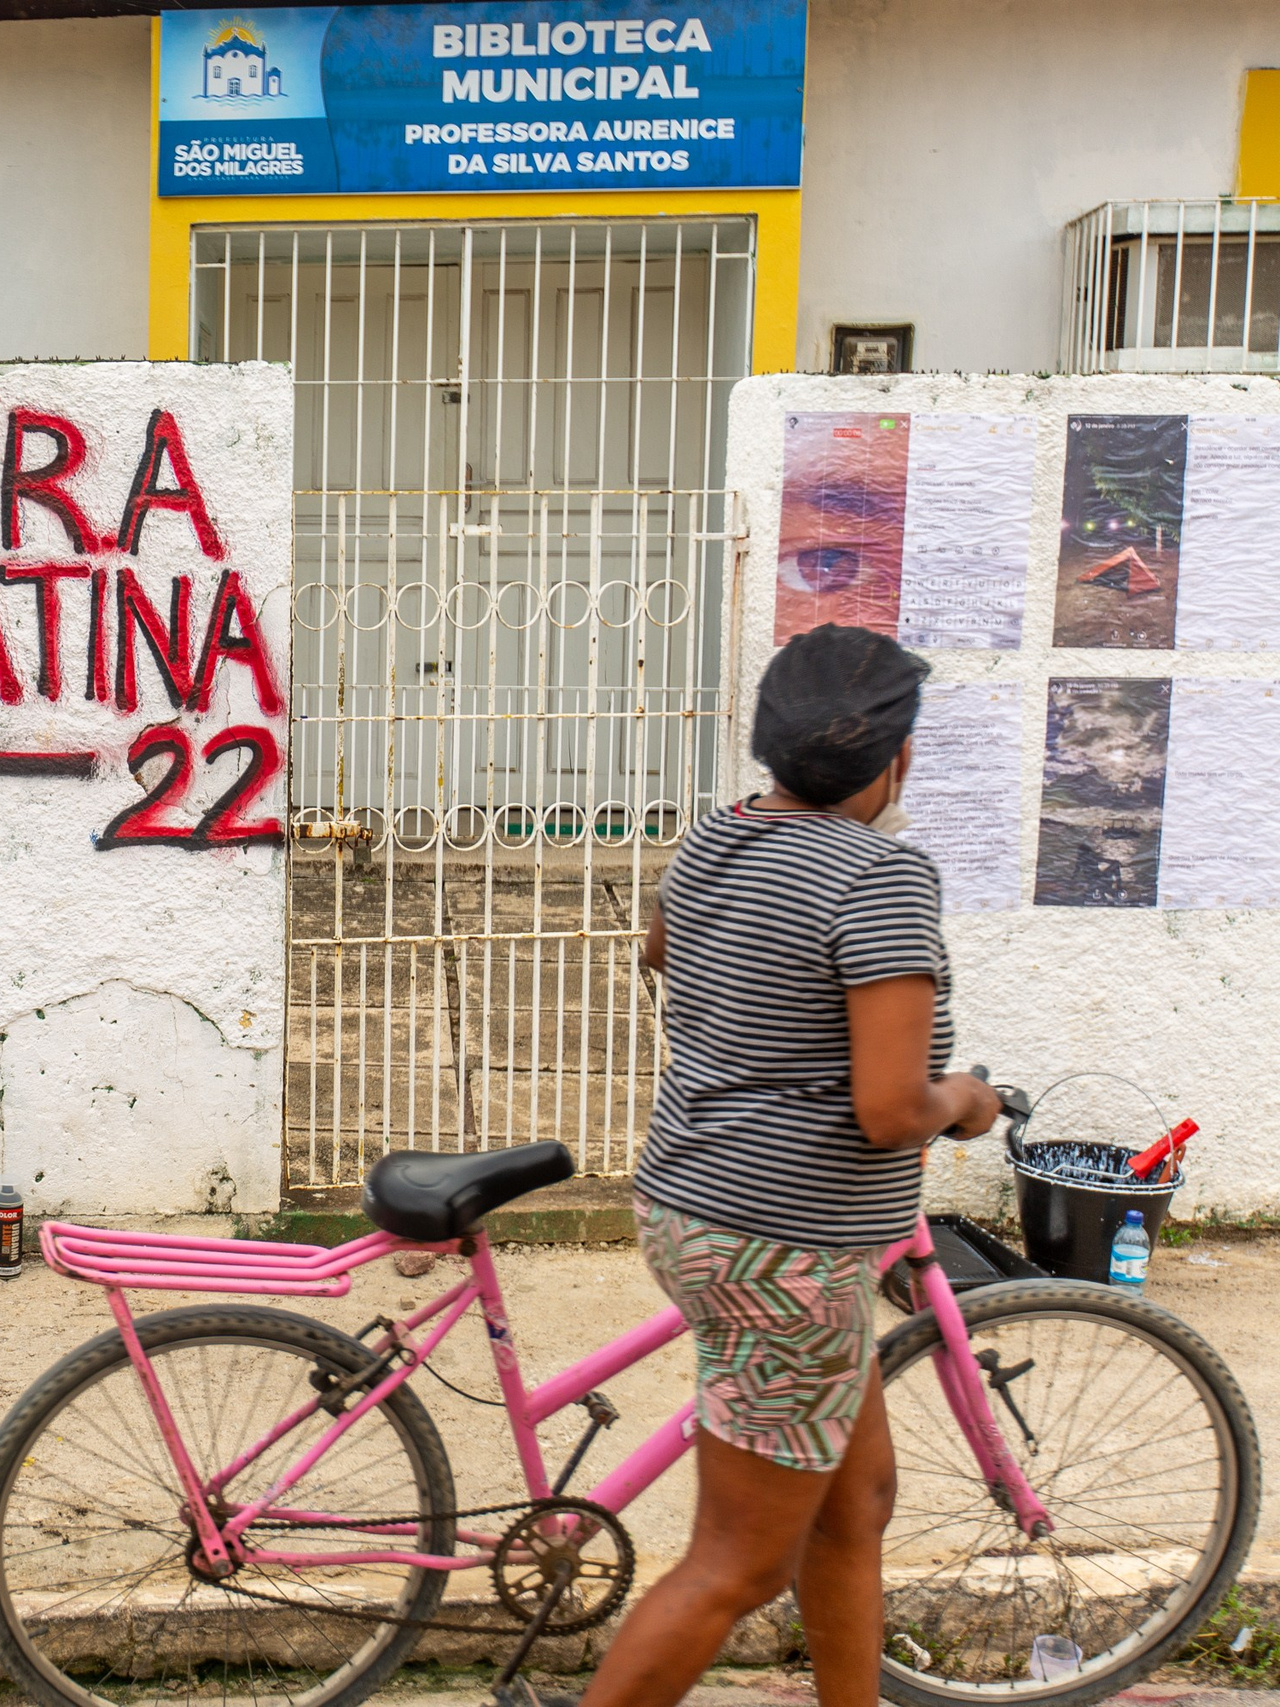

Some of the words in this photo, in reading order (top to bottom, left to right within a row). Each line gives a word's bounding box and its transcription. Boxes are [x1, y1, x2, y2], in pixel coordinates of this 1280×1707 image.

[433, 18, 713, 58] BIBLIOTECA
[442, 64, 700, 103] MUNICIPAL
[203, 135, 275, 143] PREFEITURA
[405, 120, 589, 145] PROFESSORA
[592, 118, 735, 141] AURENICE
[174, 139, 221, 162] SÃO
[222, 142, 304, 161] MIGUEL
[448, 153, 488, 174] DA
[491, 151, 573, 174] SILVA
[576, 150, 690, 172] SANTOS
[173, 161, 212, 177] DOS
[214, 159, 305, 176] MILAGRES
[92, 721, 288, 852] 22
[9, 1223, 20, 1261] URBANA
